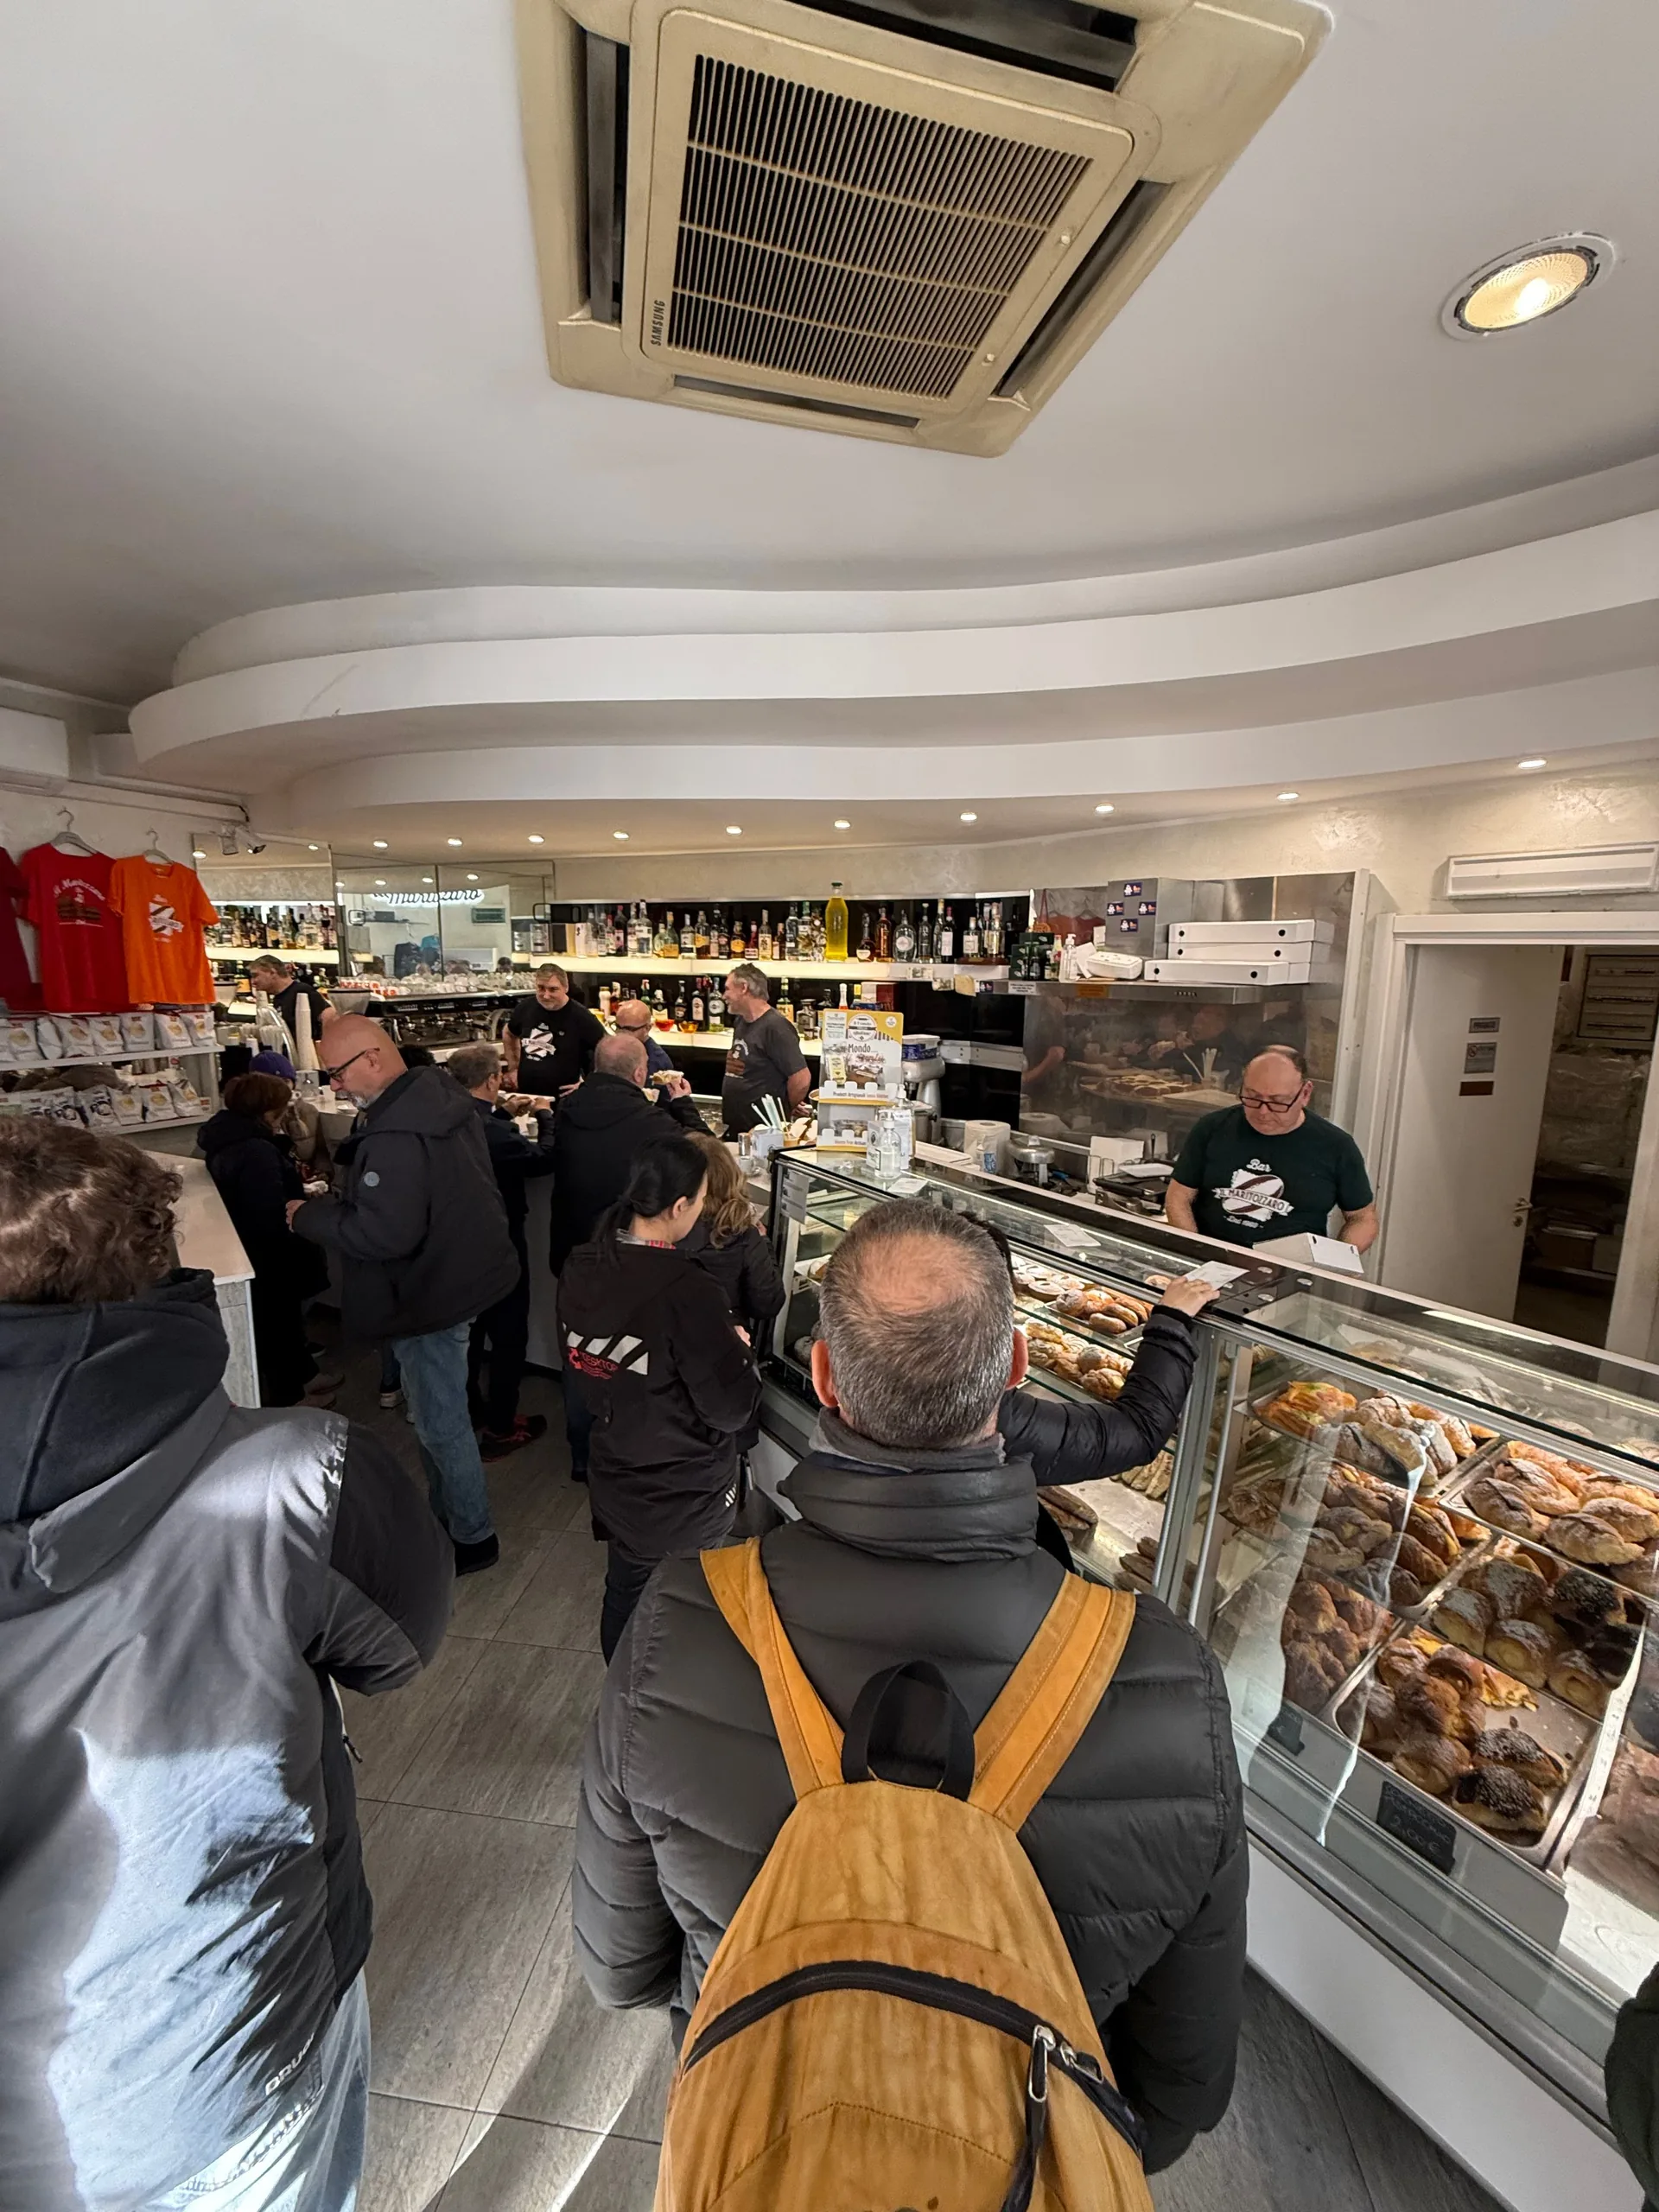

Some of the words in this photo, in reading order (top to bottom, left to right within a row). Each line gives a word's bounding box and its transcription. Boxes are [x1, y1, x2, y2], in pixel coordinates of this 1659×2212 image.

[650, 300, 665, 346] SAMSUNG
[848, 1043, 871, 1053] Mondo
[1246, 1158, 1272, 1173] Bar
[1228, 1189, 1286, 1211] MARITOZZARO
